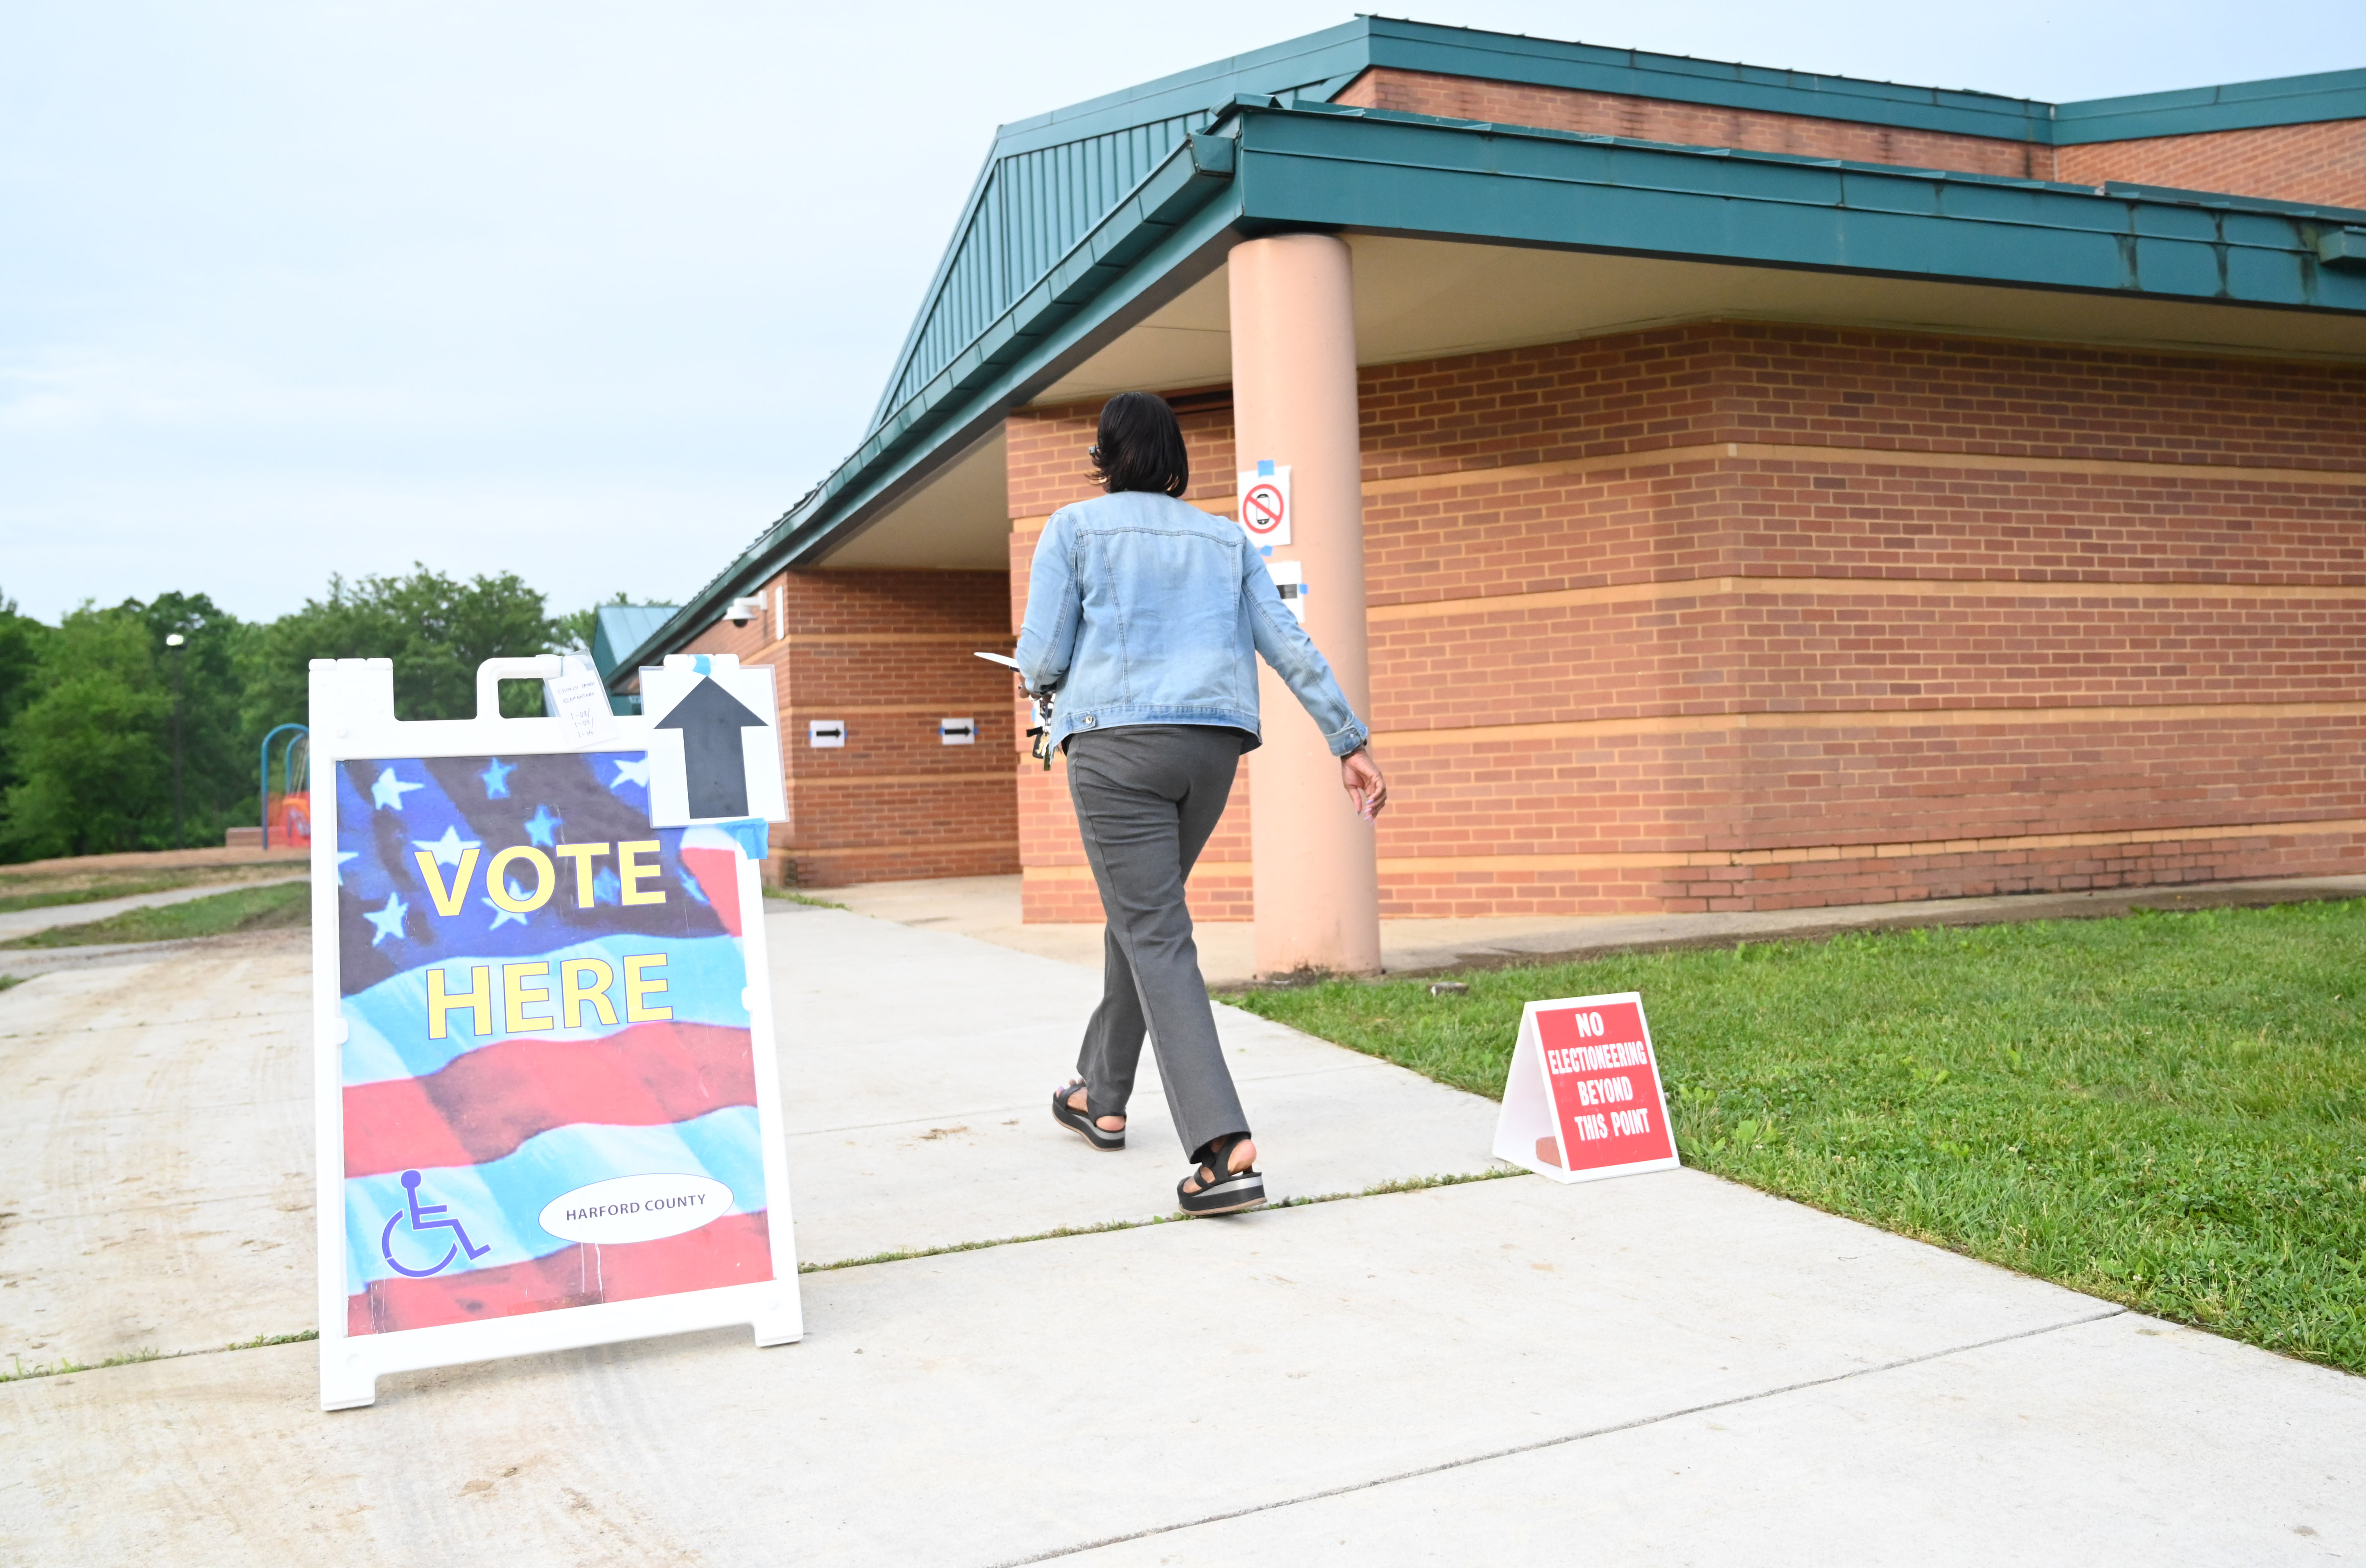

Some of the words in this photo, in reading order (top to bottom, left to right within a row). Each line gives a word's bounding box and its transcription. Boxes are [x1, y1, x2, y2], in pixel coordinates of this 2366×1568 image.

[558, 686, 579, 694] CHURCH
[578, 730, 593, 738] 1-14
[414, 839, 667, 917] VOTE
[426, 953, 673, 1040] HERE
[1575, 1012, 1604, 1037] NO
[1547, 1040, 1647, 1074] ELECTIONEERING
[1577, 1076, 1633, 1105] BEYOND
[1574, 1113, 1608, 1141] THIS
[1611, 1108, 1650, 1137] POINT
[566, 1203, 640, 1221] HARFORD
[645, 1194, 706, 1211] COUNTY
